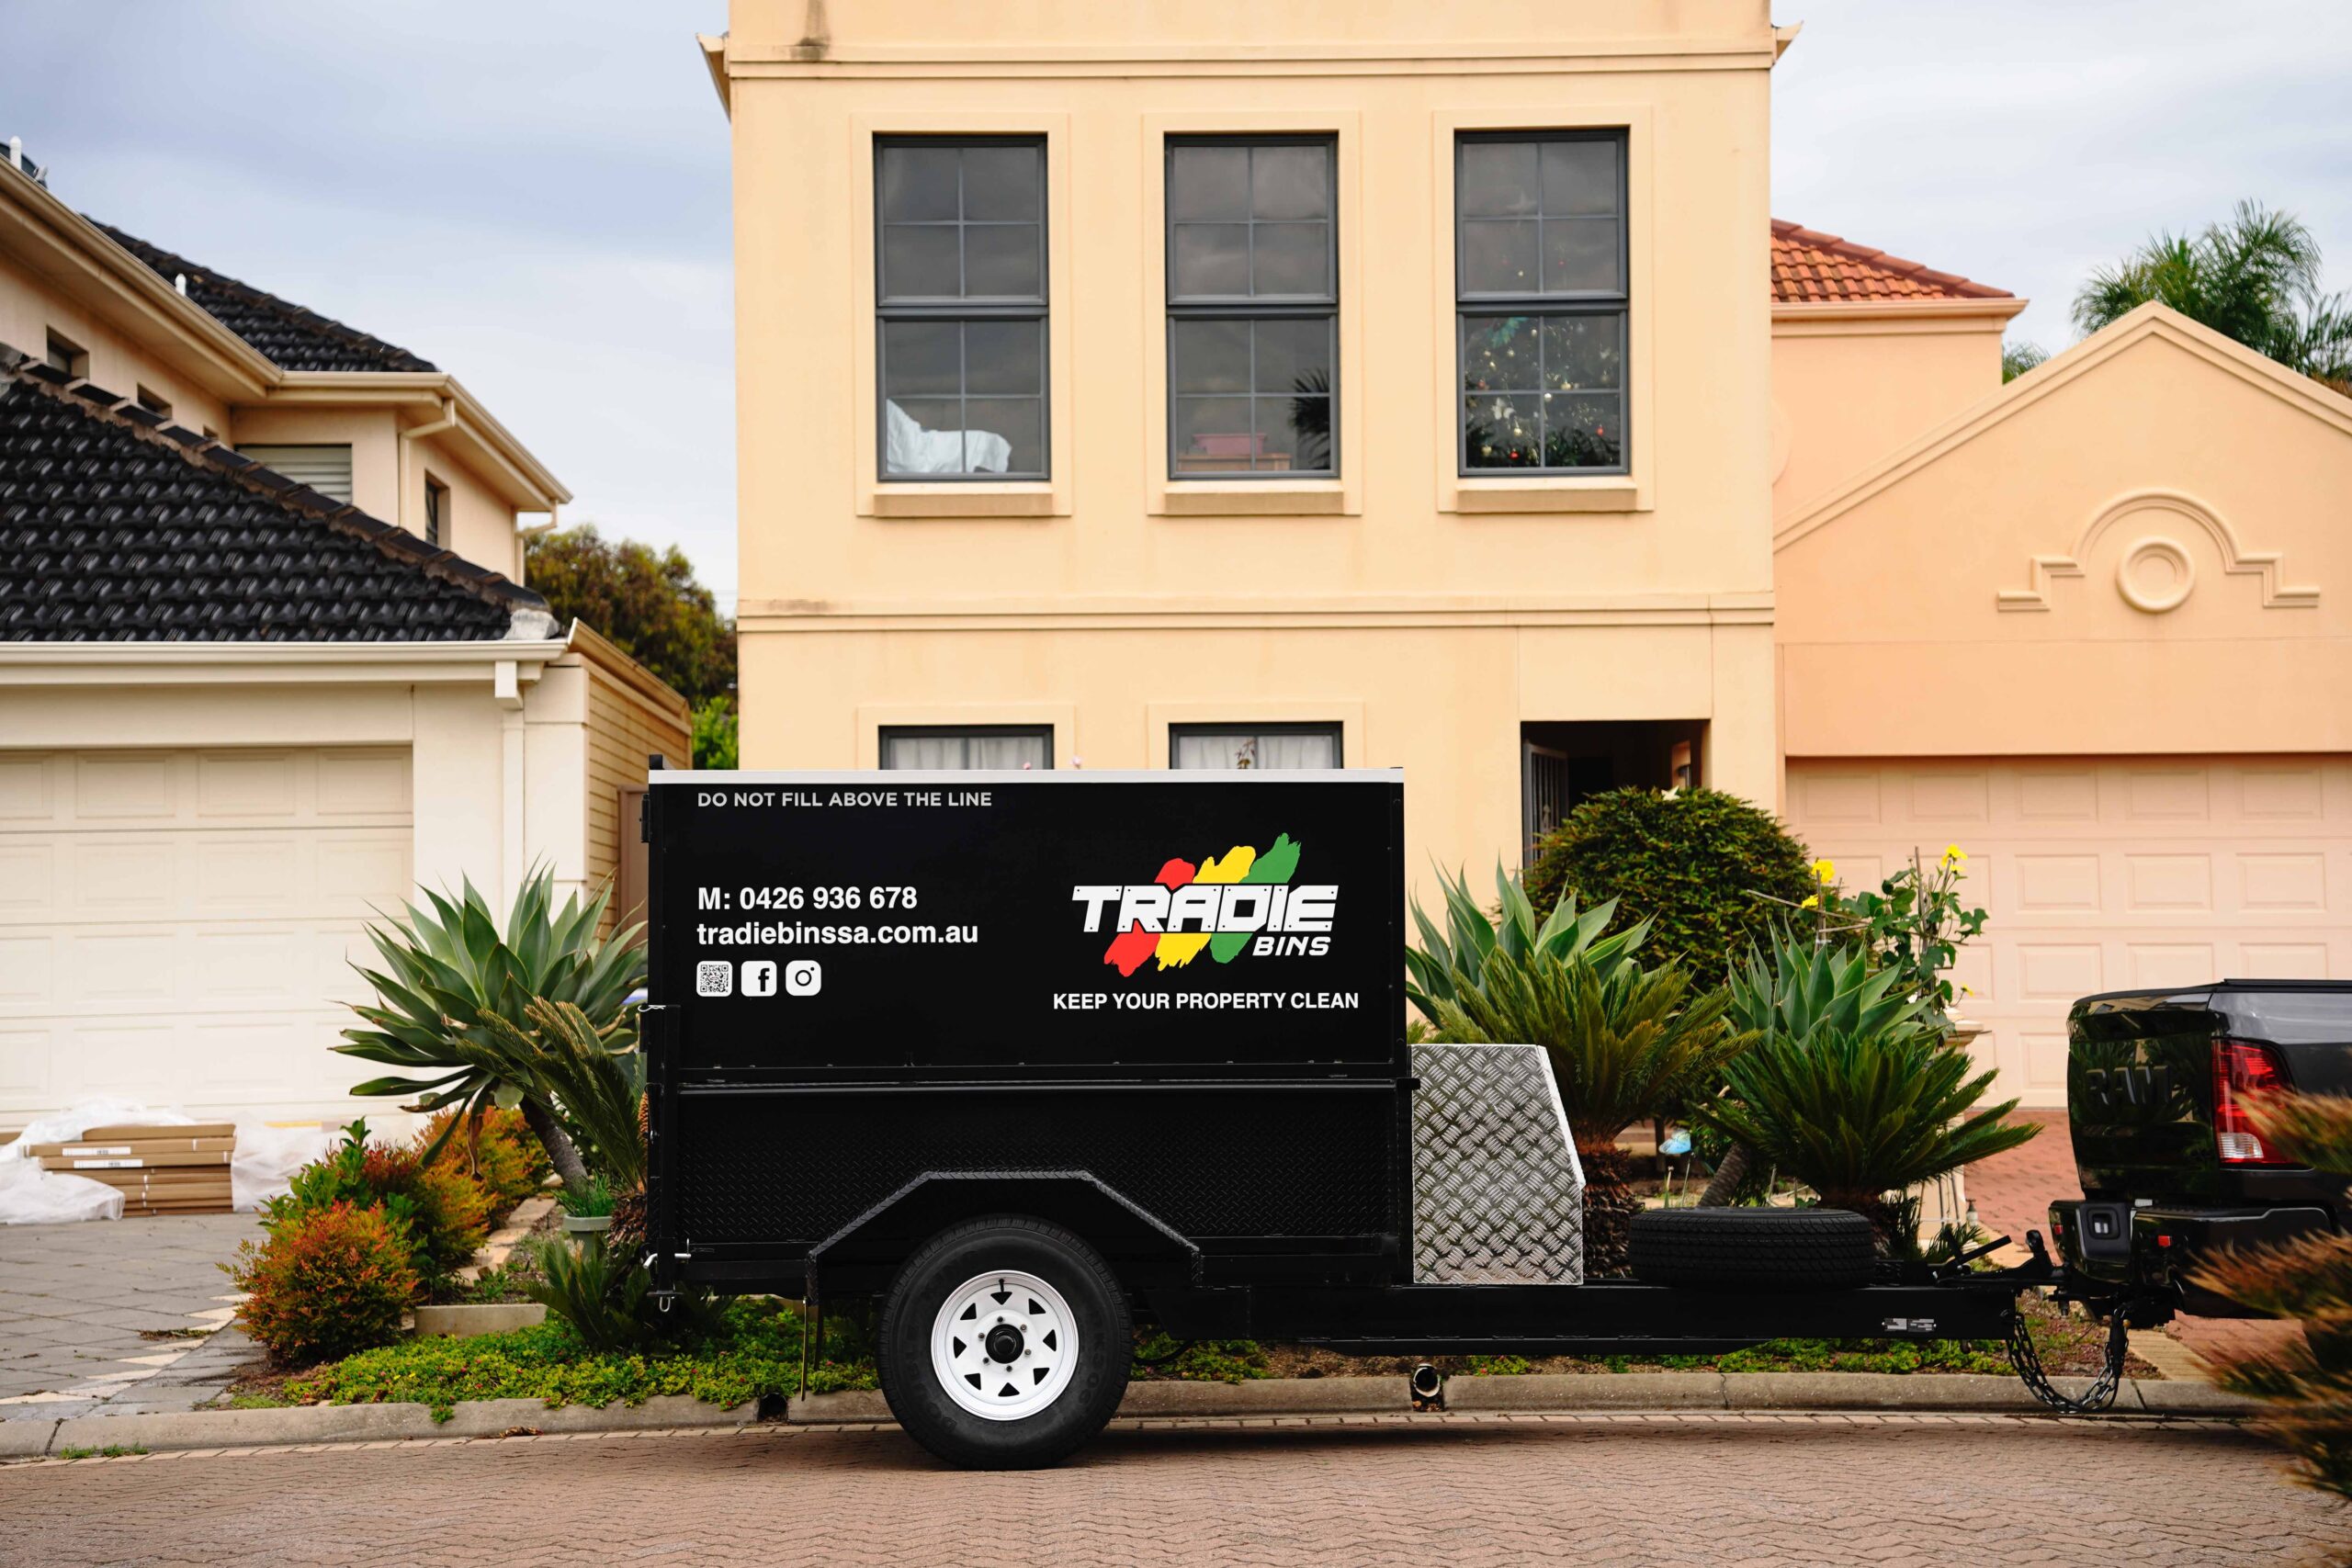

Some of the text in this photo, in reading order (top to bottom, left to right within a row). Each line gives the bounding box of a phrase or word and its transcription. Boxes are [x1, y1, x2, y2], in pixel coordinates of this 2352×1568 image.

[698, 793, 991, 807] DO NOT FILL ABOVE THE LINE
[698, 886, 917, 909] M: 0426 936 678
[1072, 886, 1339, 932] TRADIE
[697, 921, 978, 944] tradiebinssa.com.au
[1252, 936, 1331, 955] BINS
[1054, 993, 1358, 1009] KEEP YOUR PROPERTY CLEAN
[2086, 1066, 2169, 1105] RAM
